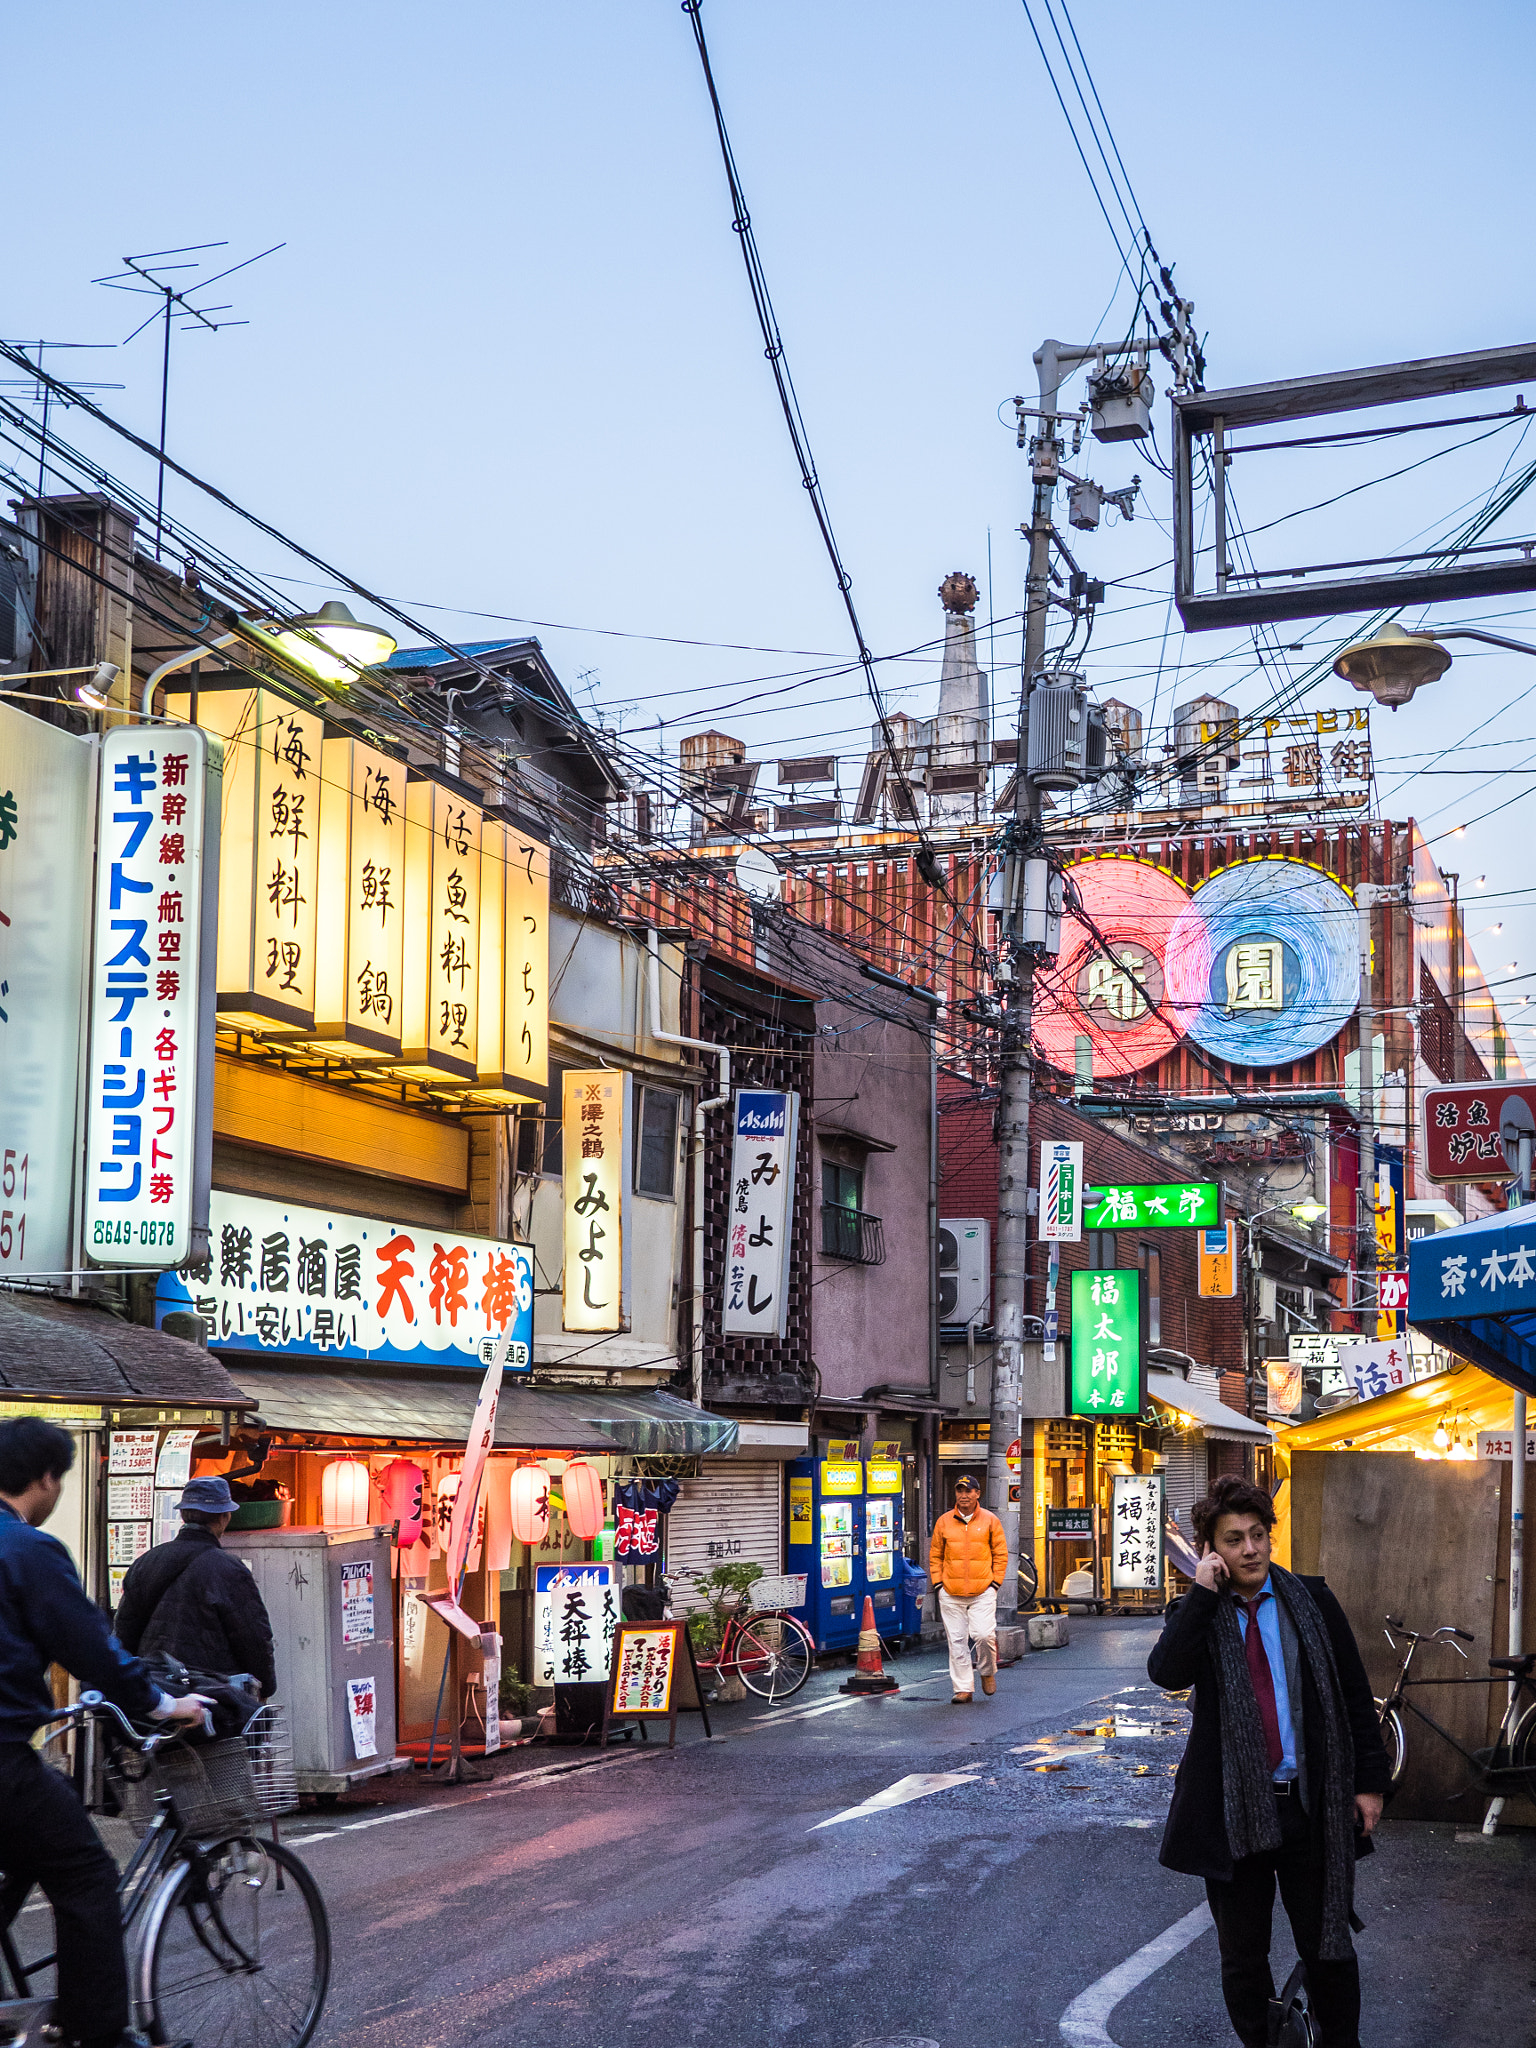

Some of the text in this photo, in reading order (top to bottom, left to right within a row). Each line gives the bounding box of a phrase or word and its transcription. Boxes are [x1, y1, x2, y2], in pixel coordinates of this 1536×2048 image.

[266, 715, 312, 995] 海鮮料理
[357, 766, 397, 1026] 海鮮鍋
[439, 804, 473, 1050] 活魚料理
[98, 750, 157, 1202] ギフトステーション
[518, 845, 537, 1065] てっちり
[739, 1110, 785, 1131] Asahi
[1436, 1100, 1490, 1127] 活魚
[1449, 1131, 1501, 1164] 炉ば
[1060, 1165, 1072, 1224] ニューホープ
[1097, 1188, 1205, 1226] 福太郎
[574, 1172, 610, 1309] みよし
[747, 1152, 780, 1316] みよし
[376, 1234, 516, 1332] 天秤棒
[728, 1265, 745, 1311] おでん
[1382, 1275, 1409, 1306] か
[483, 1342, 526, 1364] 南通店
[1091, 1275, 1122, 1382] 福太郎
[1086, 1389, 1126, 1408] 本店
[1386, 1349, 1403, 1385] 本日
[1486, 1440, 1512, 1455] カネコ
[1117, 1496, 1142, 1572] 福太郎
[559, 1591, 593, 1681] 天秤棒
